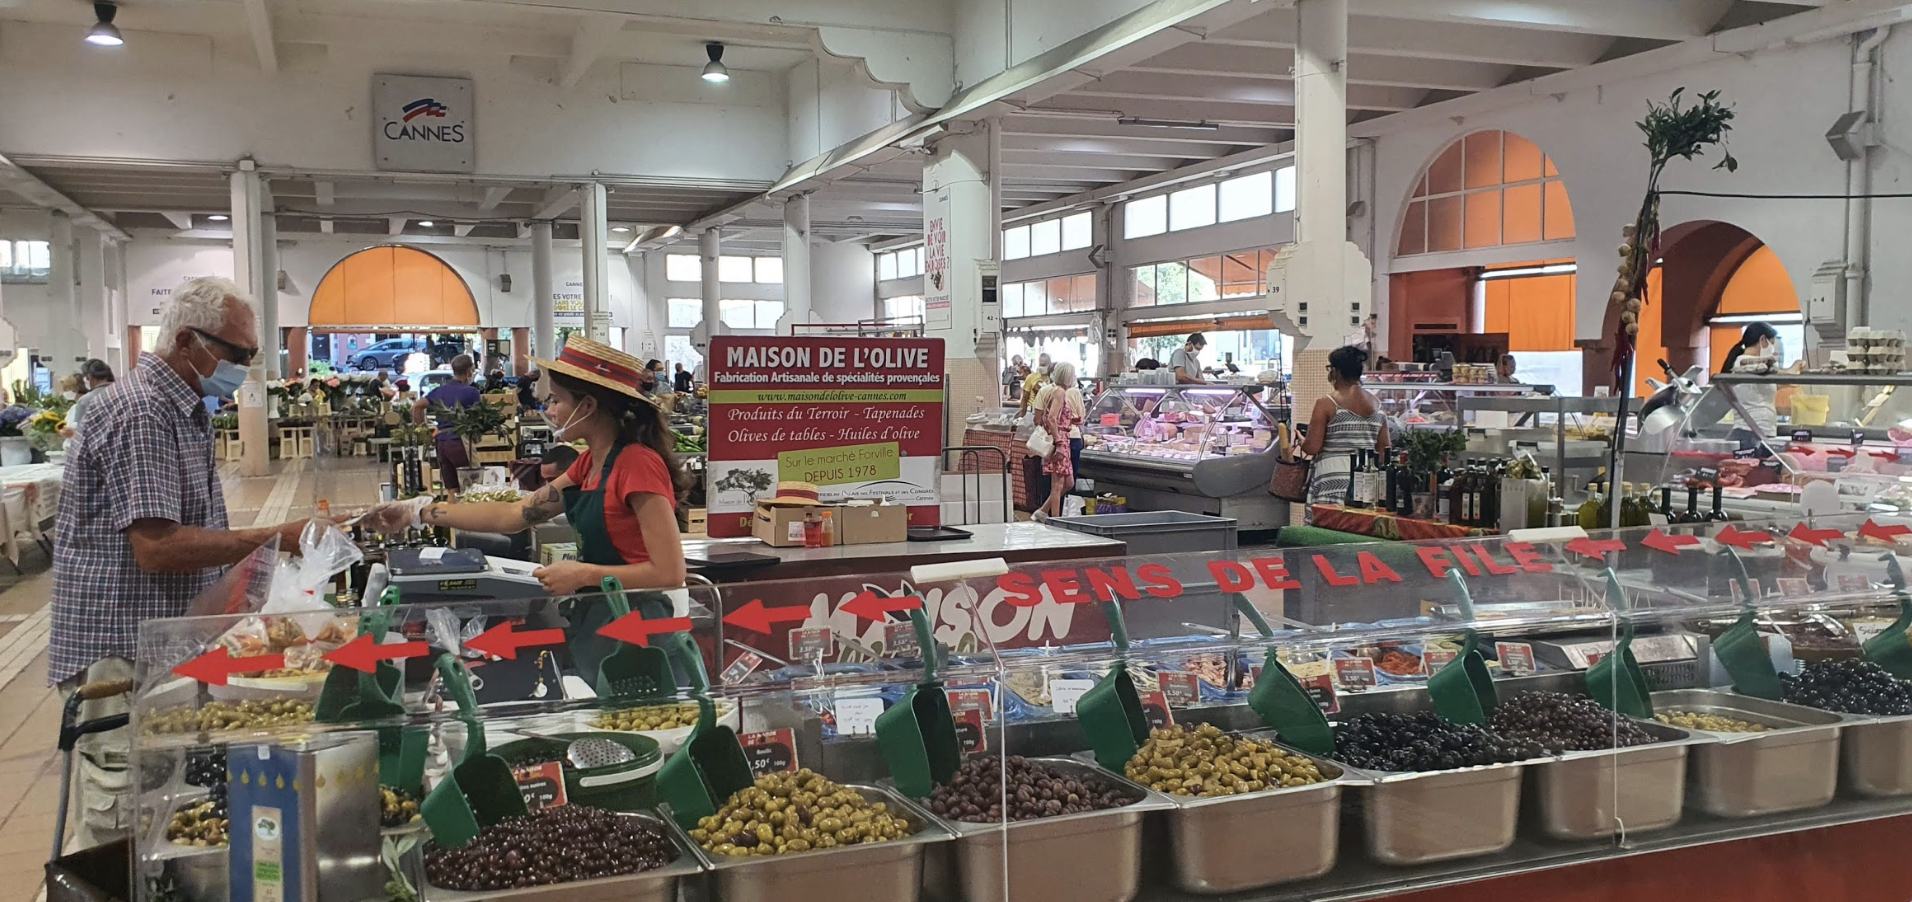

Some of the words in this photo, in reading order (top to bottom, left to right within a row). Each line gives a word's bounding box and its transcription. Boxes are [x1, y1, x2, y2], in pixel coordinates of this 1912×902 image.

[384, 121, 464, 142] CANNES
[930, 218, 943, 232] ENVIE
[930, 247, 936, 259] LA
[936, 244, 944, 257] VIE
[726, 346, 810, 368] MAISON
[819, 347, 846, 368] DE
[854, 347, 928, 368] L'OLIVE
[714, 372, 768, 383] Fabrication
[770, 372, 819, 383] Artisanale
[822, 372, 834, 383] de
[836, 372, 885, 385] spécialités
[887, 372, 940, 385] provençales
[757, 390, 906, 401] www.maisondelolive-cannes.com
[728, 406, 783, 420] Produits
[786, 406, 803, 420] du
[806, 406, 850, 420] Terroir
[863, 405, 925, 423] Tapenades
[728, 428, 768, 442] Olives
[771, 428, 786, 441] de
[790, 427, 826, 441] tables
[837, 427, 878, 440] Huiles
[880, 426, 920, 440] d'olive
[786, 456, 800, 468] Sur
[804, 455, 814, 466] le
[818, 452, 856, 464] marché
[859, 447, 893, 461] Forville
[804, 468, 844, 483] DEPUIS
[849, 465, 877, 478] 1978
[996, 563, 1184, 606] SENS
[1206, 557, 1301, 593] DE
[1312, 552, 1402, 586] LA
[1415, 542, 1553, 578] FILE
